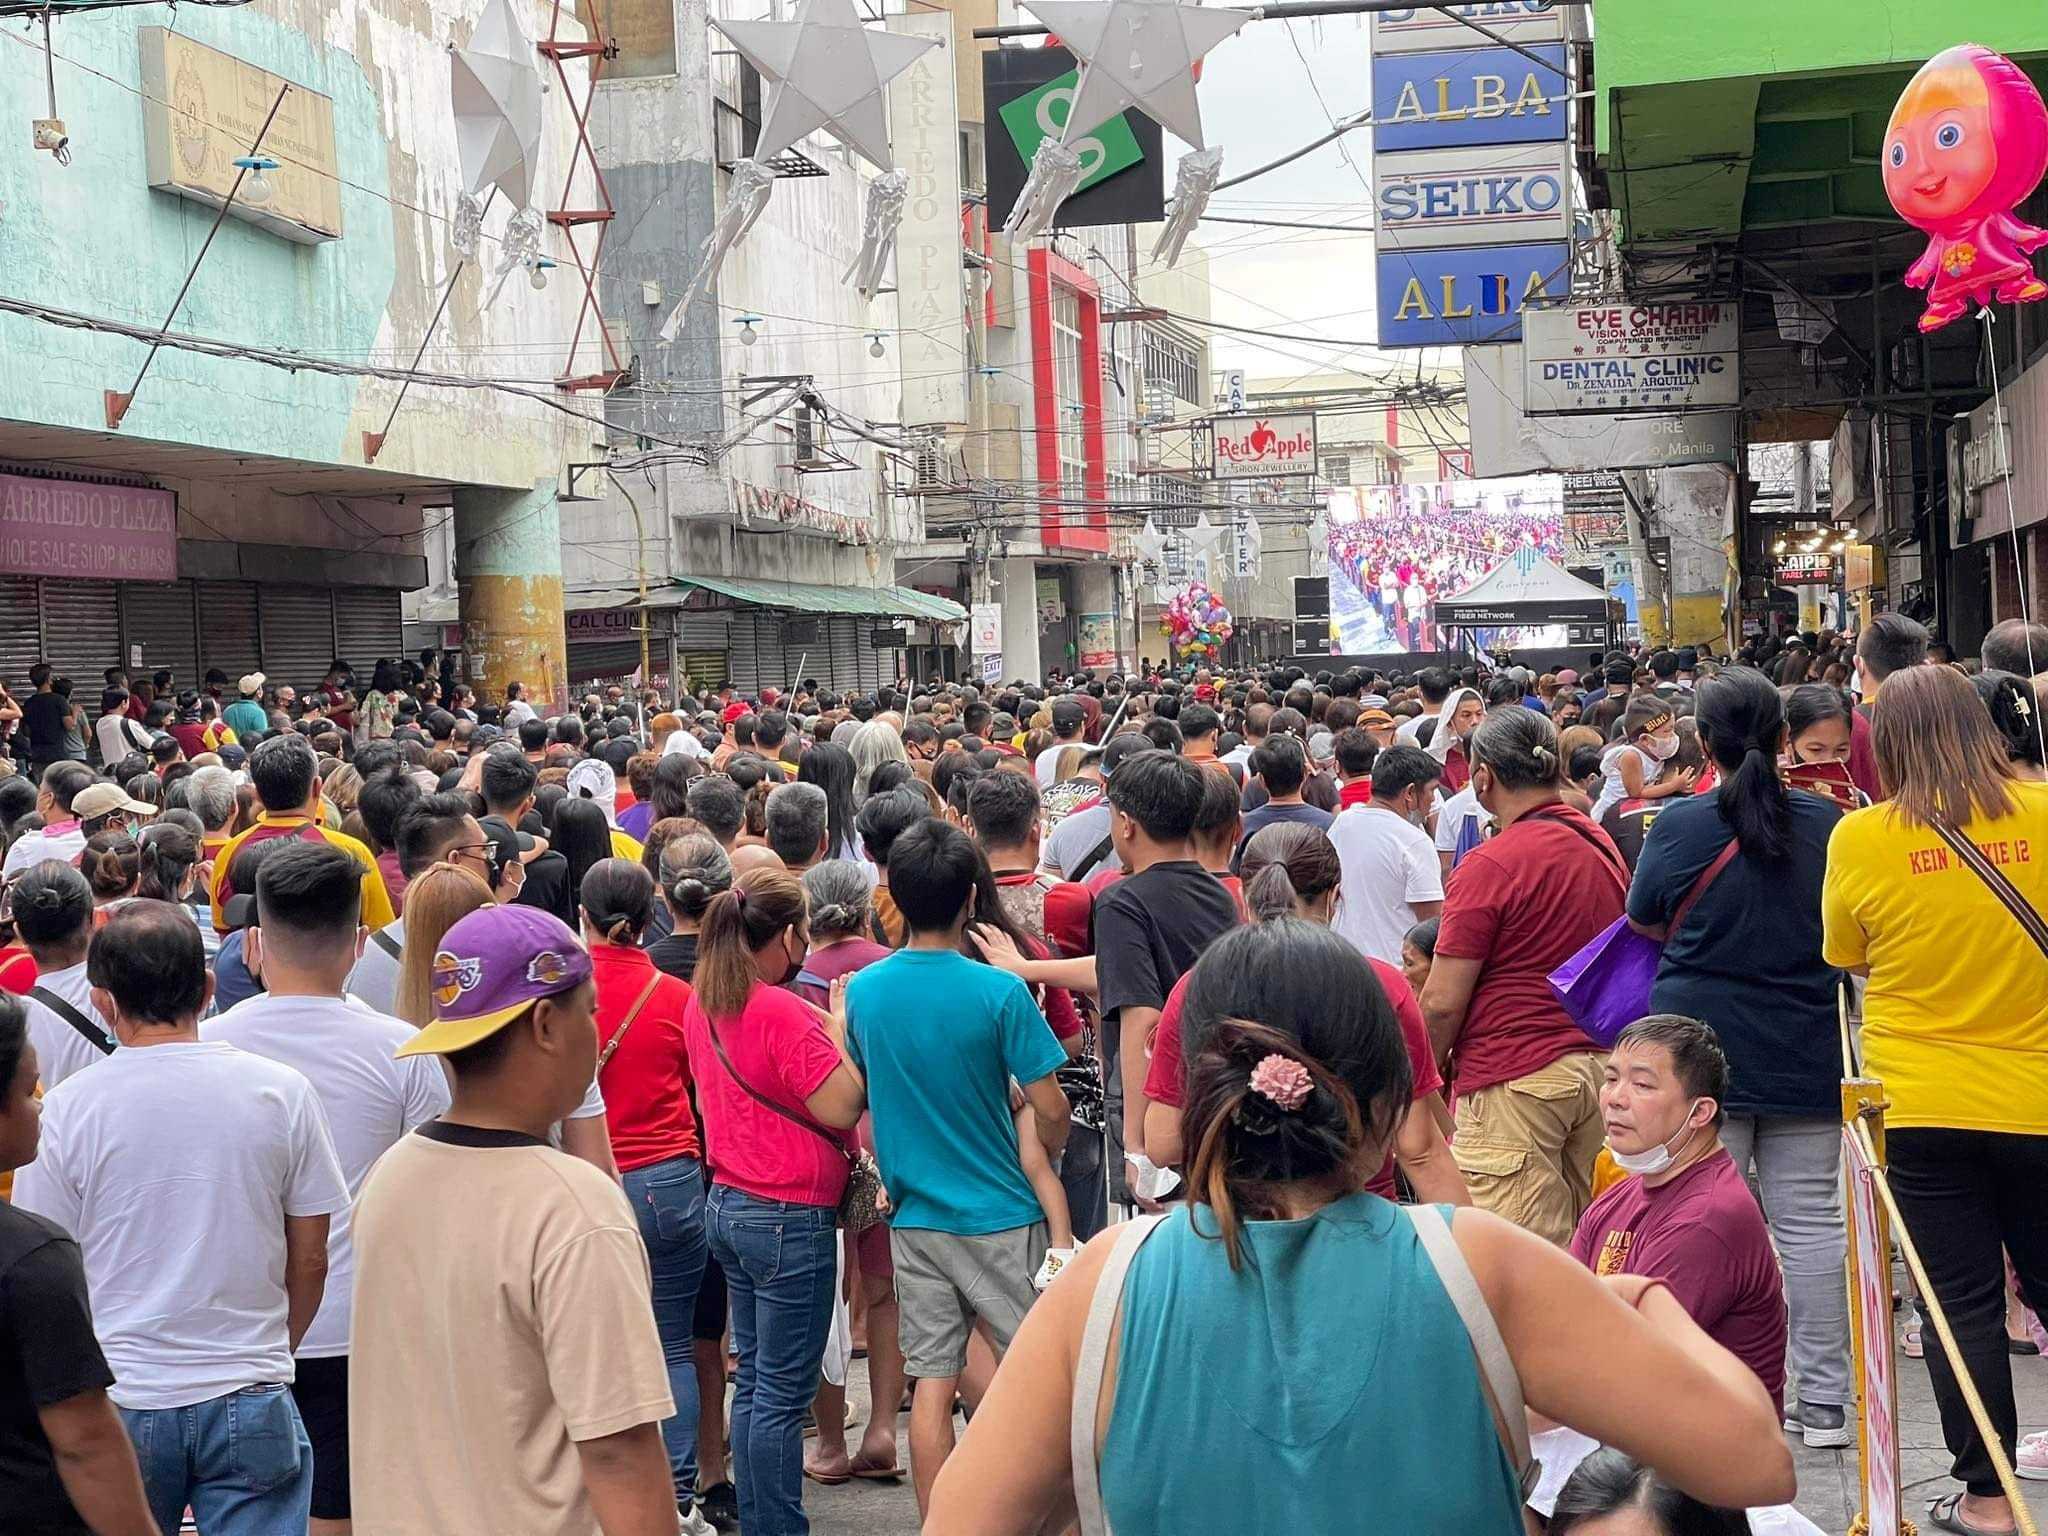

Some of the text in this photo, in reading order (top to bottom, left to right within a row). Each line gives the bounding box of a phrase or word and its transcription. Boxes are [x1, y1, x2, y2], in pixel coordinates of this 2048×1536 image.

[1394, 73, 1551, 122] ALBA
[1381, 174, 1561, 220] SEIKO
[917, 245, 945, 362] PLAZA
[1393, 271, 1551, 320] ALBA
[1577, 304, 1720, 330] EYE CHARM
[1588, 323, 1710, 339] VISION CARE CENTER
[1597, 335, 1701, 345] COMPUTERIZED REFRACTION
[1543, 355, 1725, 380] DENTAL CLINIC
[1584, 377, 1633, 390] ZENAIDA
[1640, 375, 1700, 387] ARQUILLA
[1218, 433, 1312, 461] Red Apple
[1669, 442, 1715, 455] Manila
[110, 498, 174, 533] PLAZA
[1454, 612, 1516, 620] FIBER NETWORK
[984, 660, 1001, 672] EXIT
[1909, 847, 1949, 874] KEIN
[2014, 839, 2030, 862] 12
